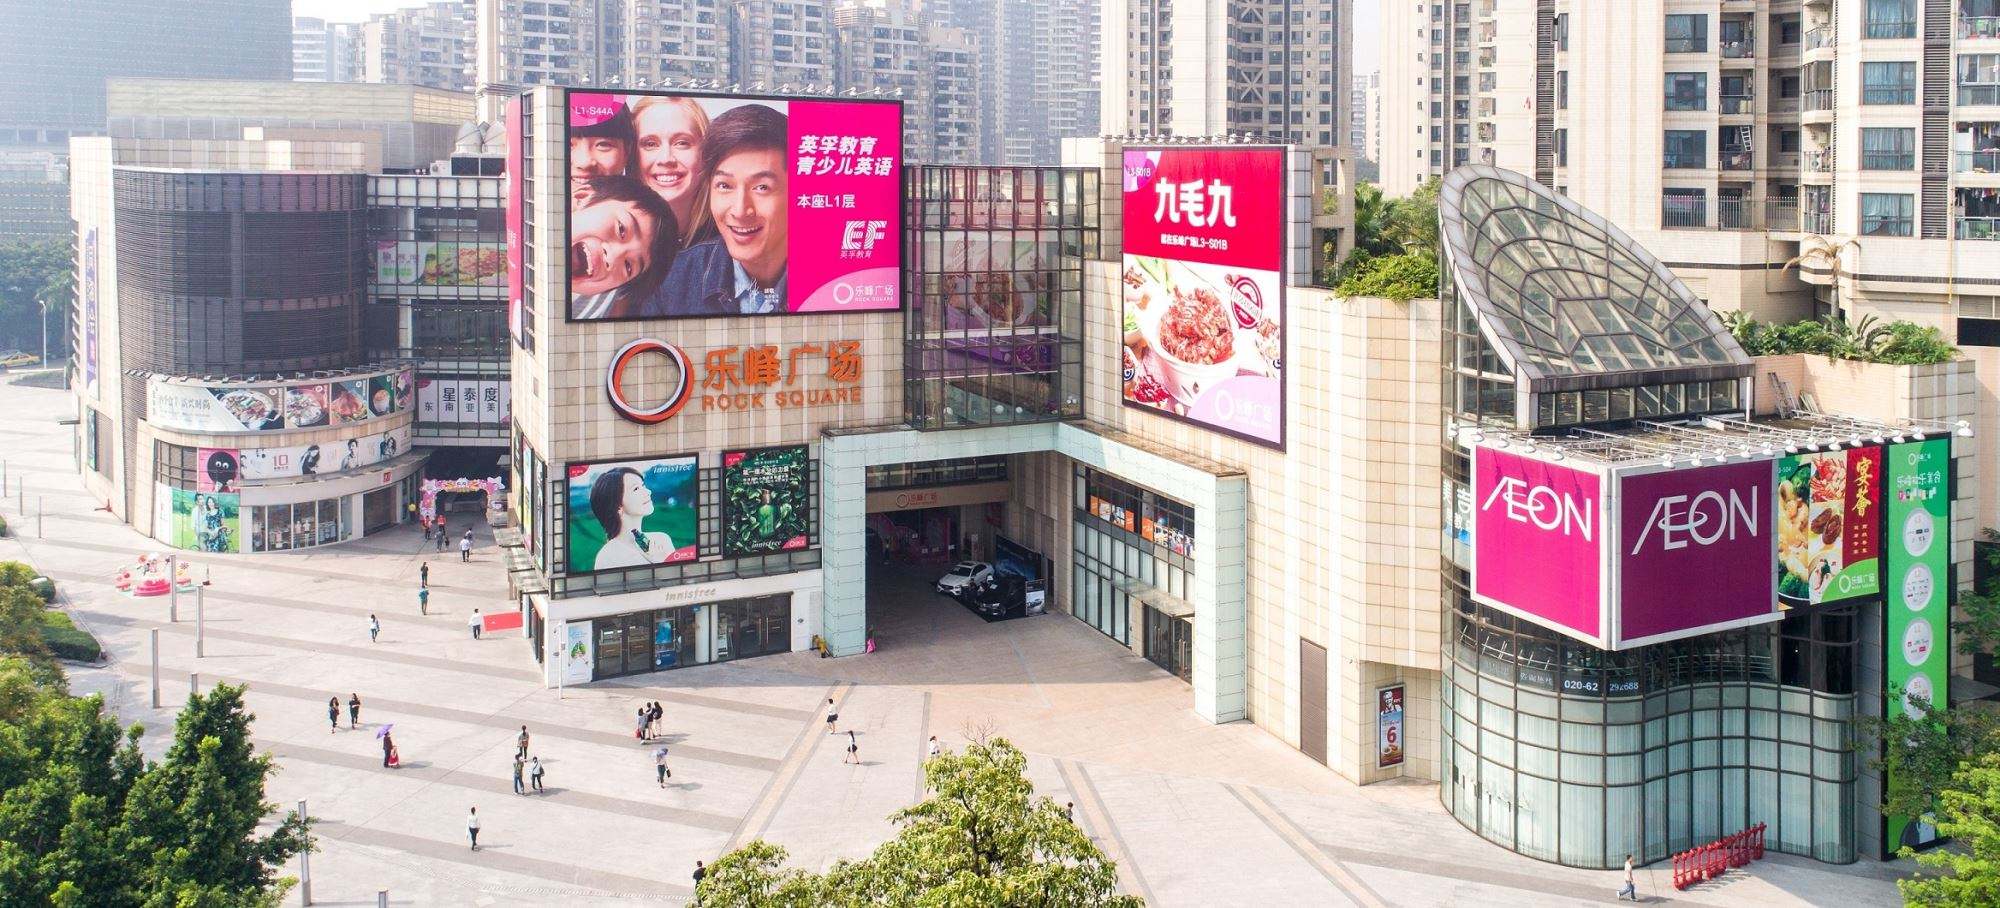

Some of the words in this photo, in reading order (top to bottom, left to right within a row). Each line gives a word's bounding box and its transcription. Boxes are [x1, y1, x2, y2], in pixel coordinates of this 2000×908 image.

[575, 106, 614, 115] L1-S44A
[798, 135, 877, 155] 英孚教育
[796, 157, 893, 175] 青少儿英语
[797, 195, 855, 208] 本座L1层
[1154, 176, 1237, 228] 九毛九
[841, 220, 888, 250] EF
[702, 340, 864, 390] 乐峰广场
[443, 387, 498, 402] 星泰度
[701, 394, 764, 411] ROCK
[774, 387, 862, 407] SQUARE
[664, 588, 717, 601] innisfree
[1387, 726, 1397, 743] 6
